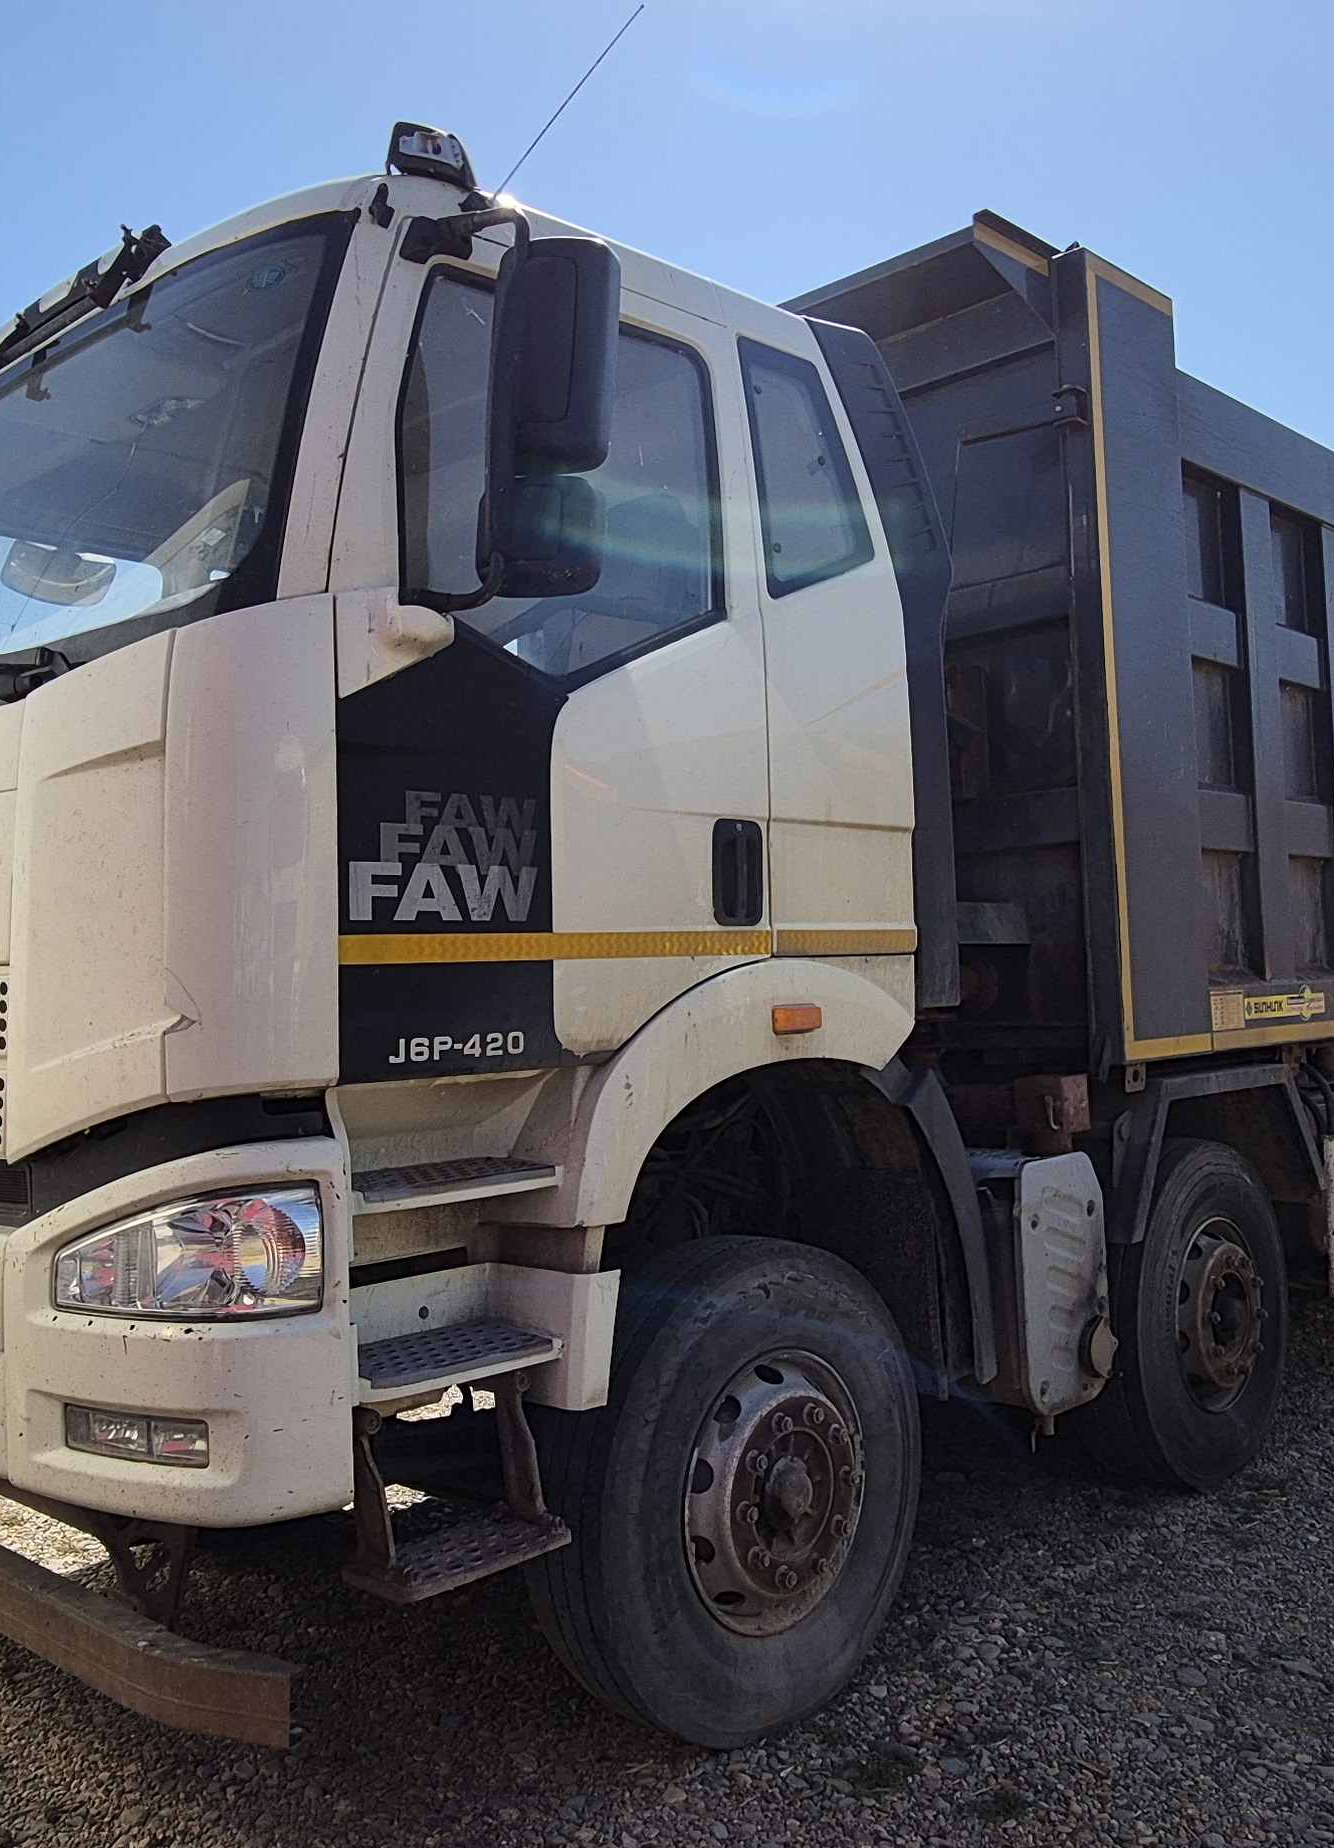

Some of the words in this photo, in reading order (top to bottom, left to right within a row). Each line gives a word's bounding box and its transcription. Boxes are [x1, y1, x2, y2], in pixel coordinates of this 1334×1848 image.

[405, 790, 536, 839] FAW
[380, 822, 538, 876] FAW
[349, 861, 538, 921] FAW
[388, 1031, 525, 1063] J6P-420
